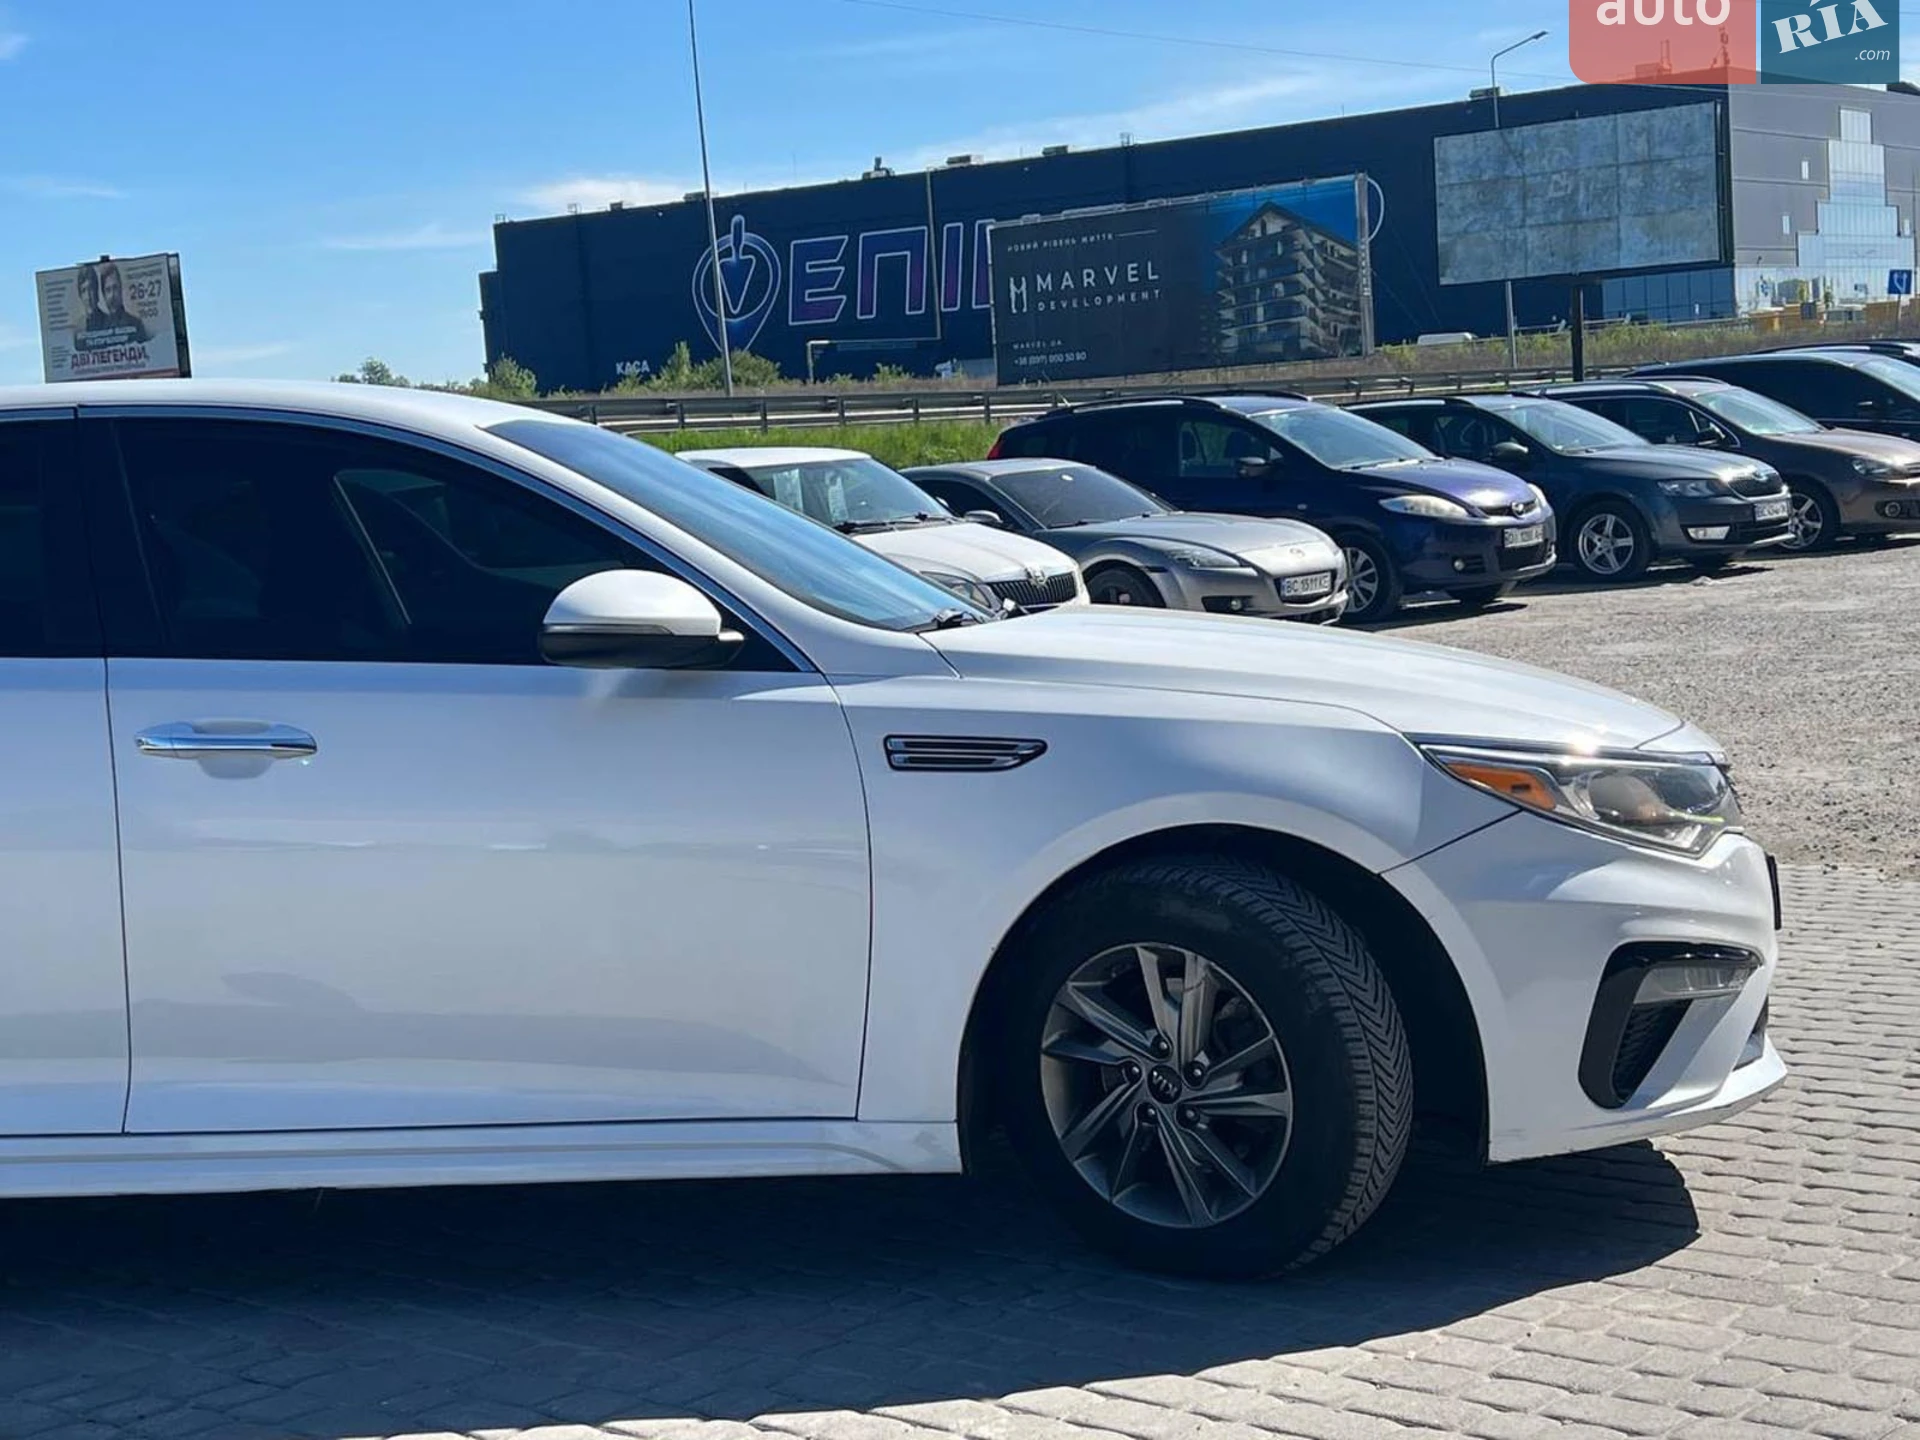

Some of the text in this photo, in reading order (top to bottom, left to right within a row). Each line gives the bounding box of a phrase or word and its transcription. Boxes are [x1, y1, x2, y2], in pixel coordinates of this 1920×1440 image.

[1036, 260, 1160, 293] MARVEL
[129, 280, 162, 300] 26-27
[1037, 289, 1161, 311] DEVELOPMENT
[615, 359, 651, 376] КАСА
